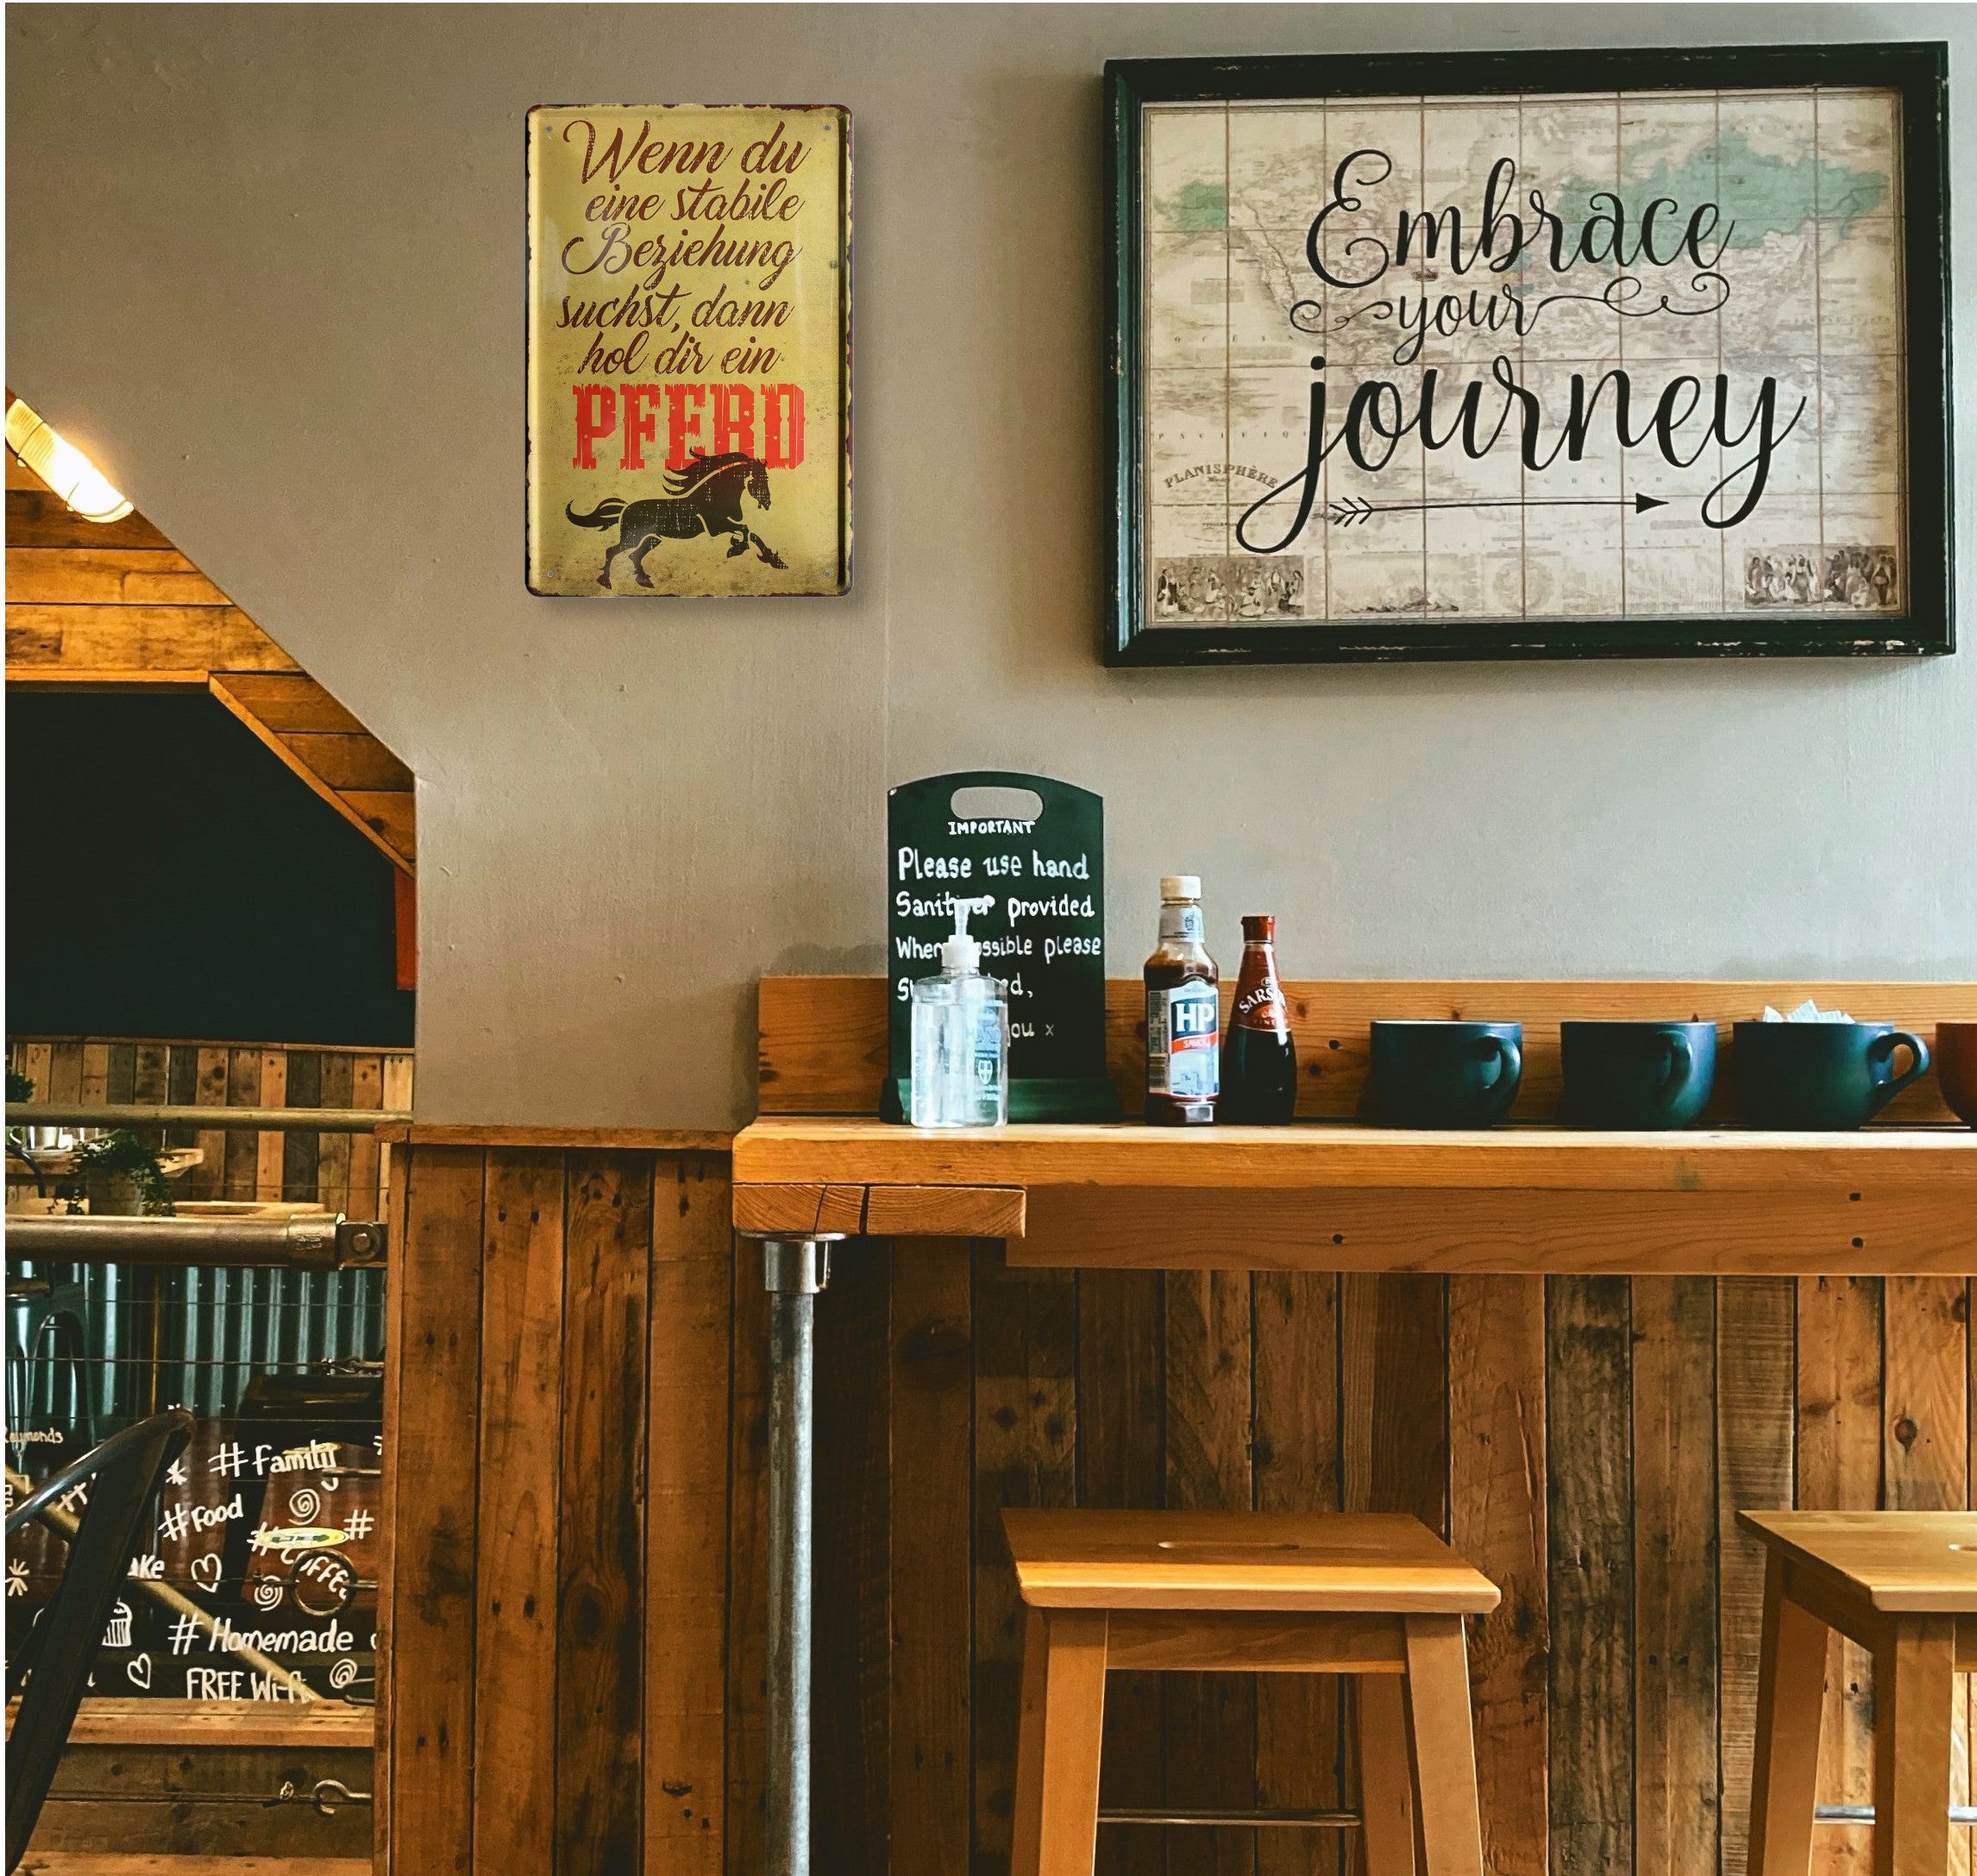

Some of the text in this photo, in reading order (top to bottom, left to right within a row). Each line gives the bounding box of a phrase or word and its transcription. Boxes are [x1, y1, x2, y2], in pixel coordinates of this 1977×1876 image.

[562, 120, 811, 185] Wenn du
[585, 178, 806, 222] eine stabile
[1305, 148, 1735, 290] Embrace
[562, 222, 805, 291] Beziehung
[556, 283, 794, 335] suchst, dann
[1393, 278, 1544, 365] your
[578, 330, 781, 376] hol dir ein
[572, 382, 806, 470] PFERD
[1236, 354, 1807, 553] journey
[948, 820, 1035, 836] IMPORTANT
[898, 847, 1089, 881] Please use hand
[1007, 893, 1095, 928] provided
[978, 935, 1032, 957] ssible
[1045, 936, 1101, 964] please
[1176, 1003, 1214, 1032] HP
[186, 1666, 244, 1702] FREE
